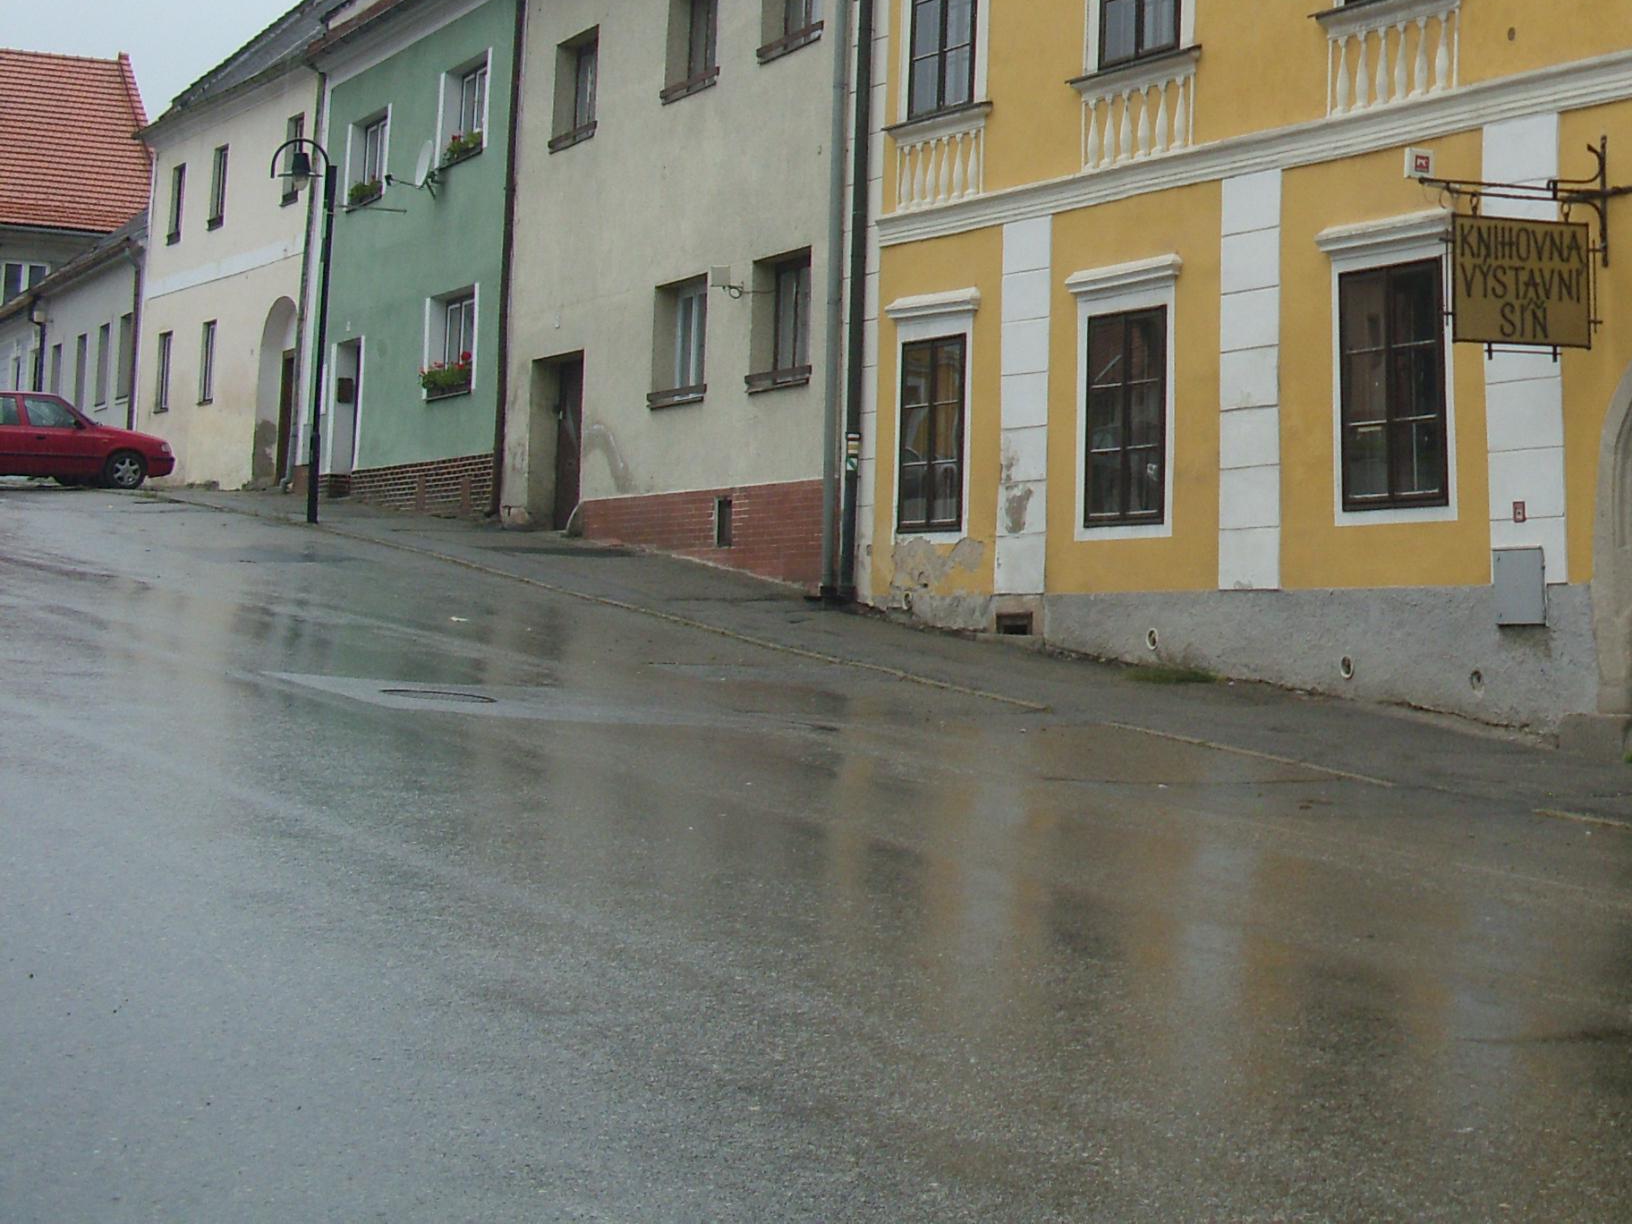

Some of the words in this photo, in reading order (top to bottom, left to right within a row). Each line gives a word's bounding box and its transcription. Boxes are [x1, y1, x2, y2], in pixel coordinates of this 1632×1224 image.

[1460, 224, 1584, 264] KNIHOVNA
[1460, 257, 1587, 303] VÝSTAVNÍ
[1499, 297, 1549, 339] SÍŇ
